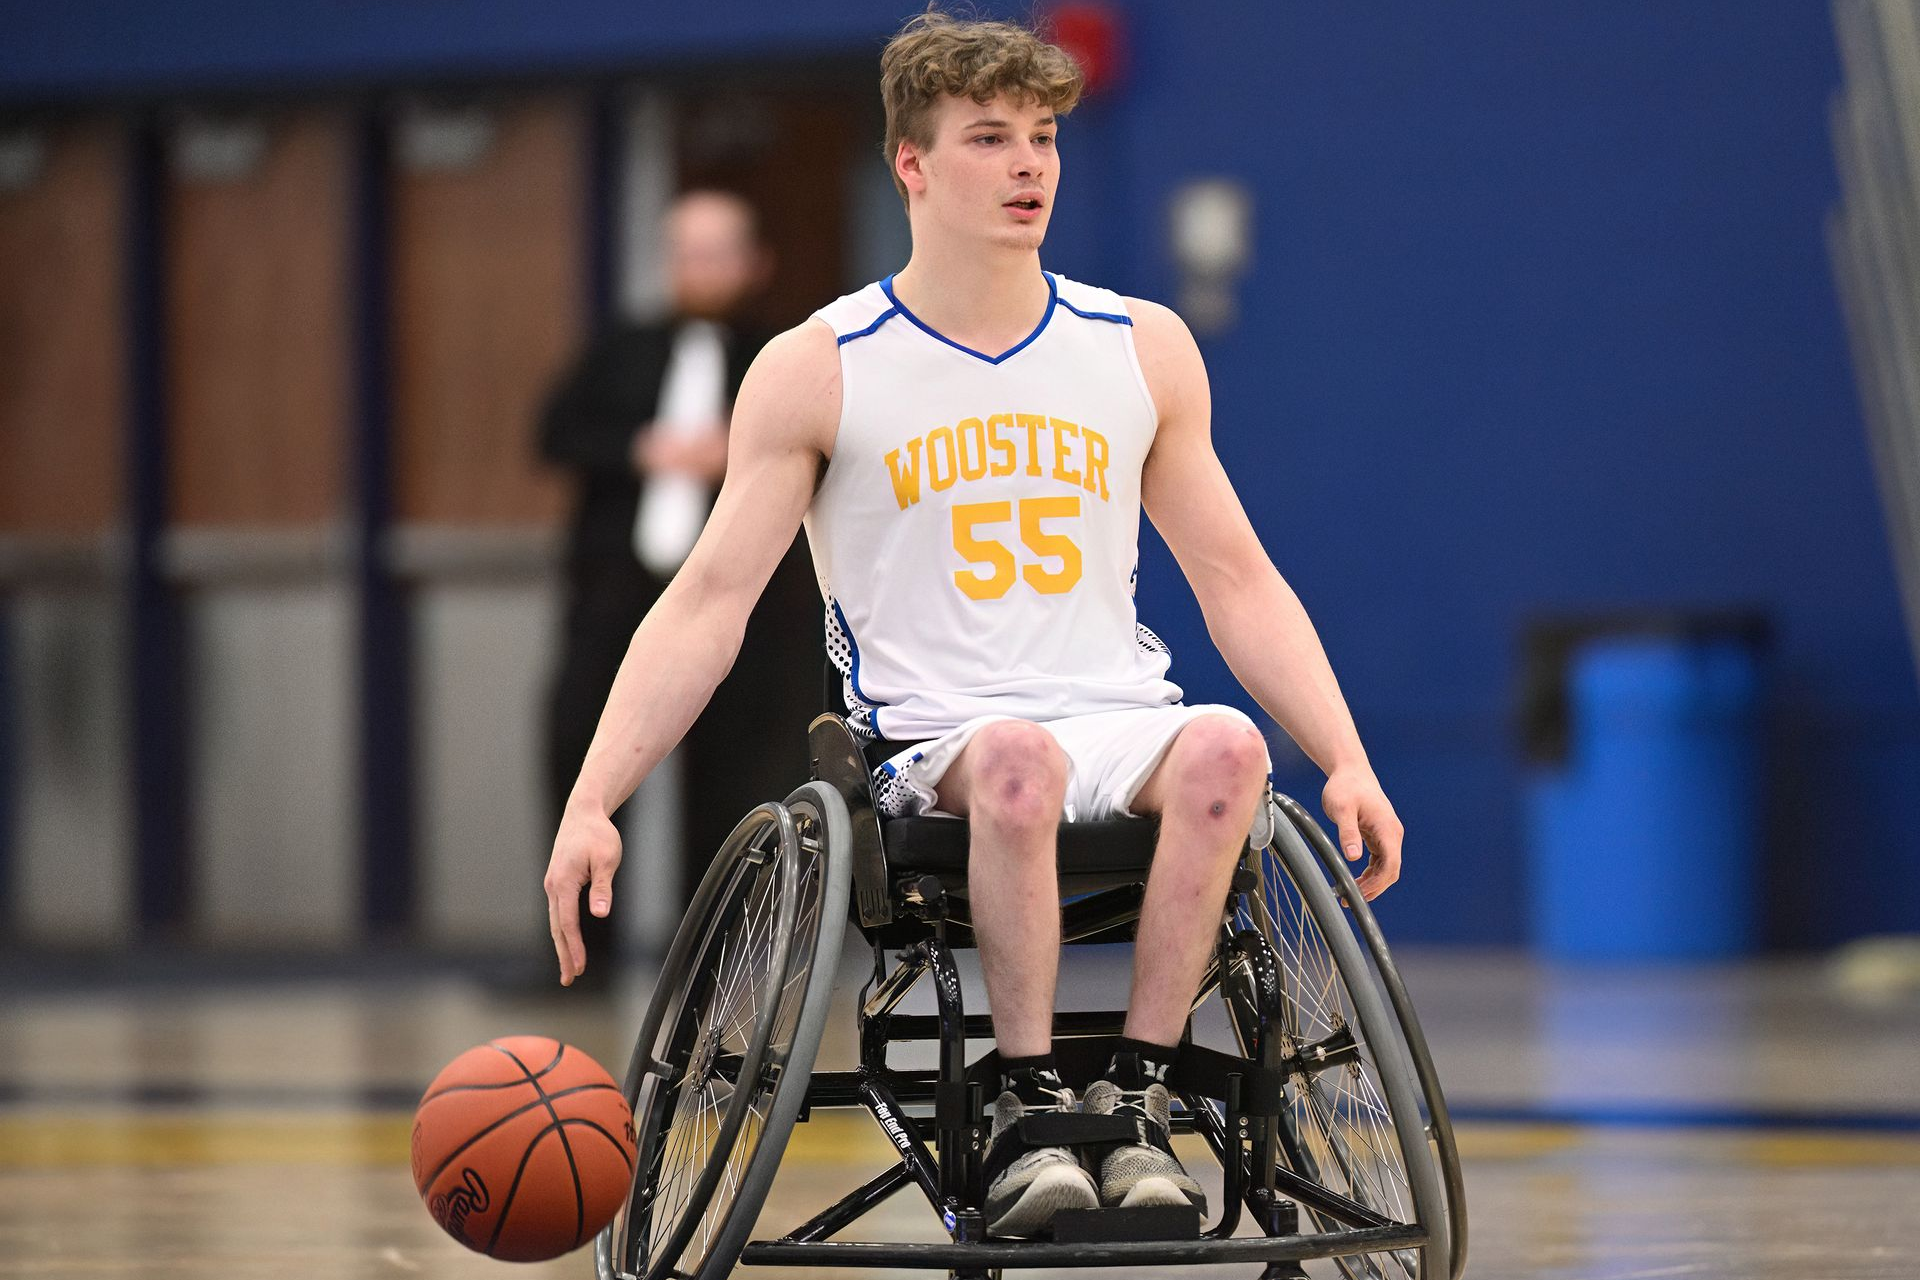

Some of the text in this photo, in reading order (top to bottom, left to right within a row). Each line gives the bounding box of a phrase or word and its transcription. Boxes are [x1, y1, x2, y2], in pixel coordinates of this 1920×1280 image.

[884, 413, 1110, 511] WOOSTER
[952, 496, 1082, 600] 55
[875, 1102, 911, 1149] Top End Pro
